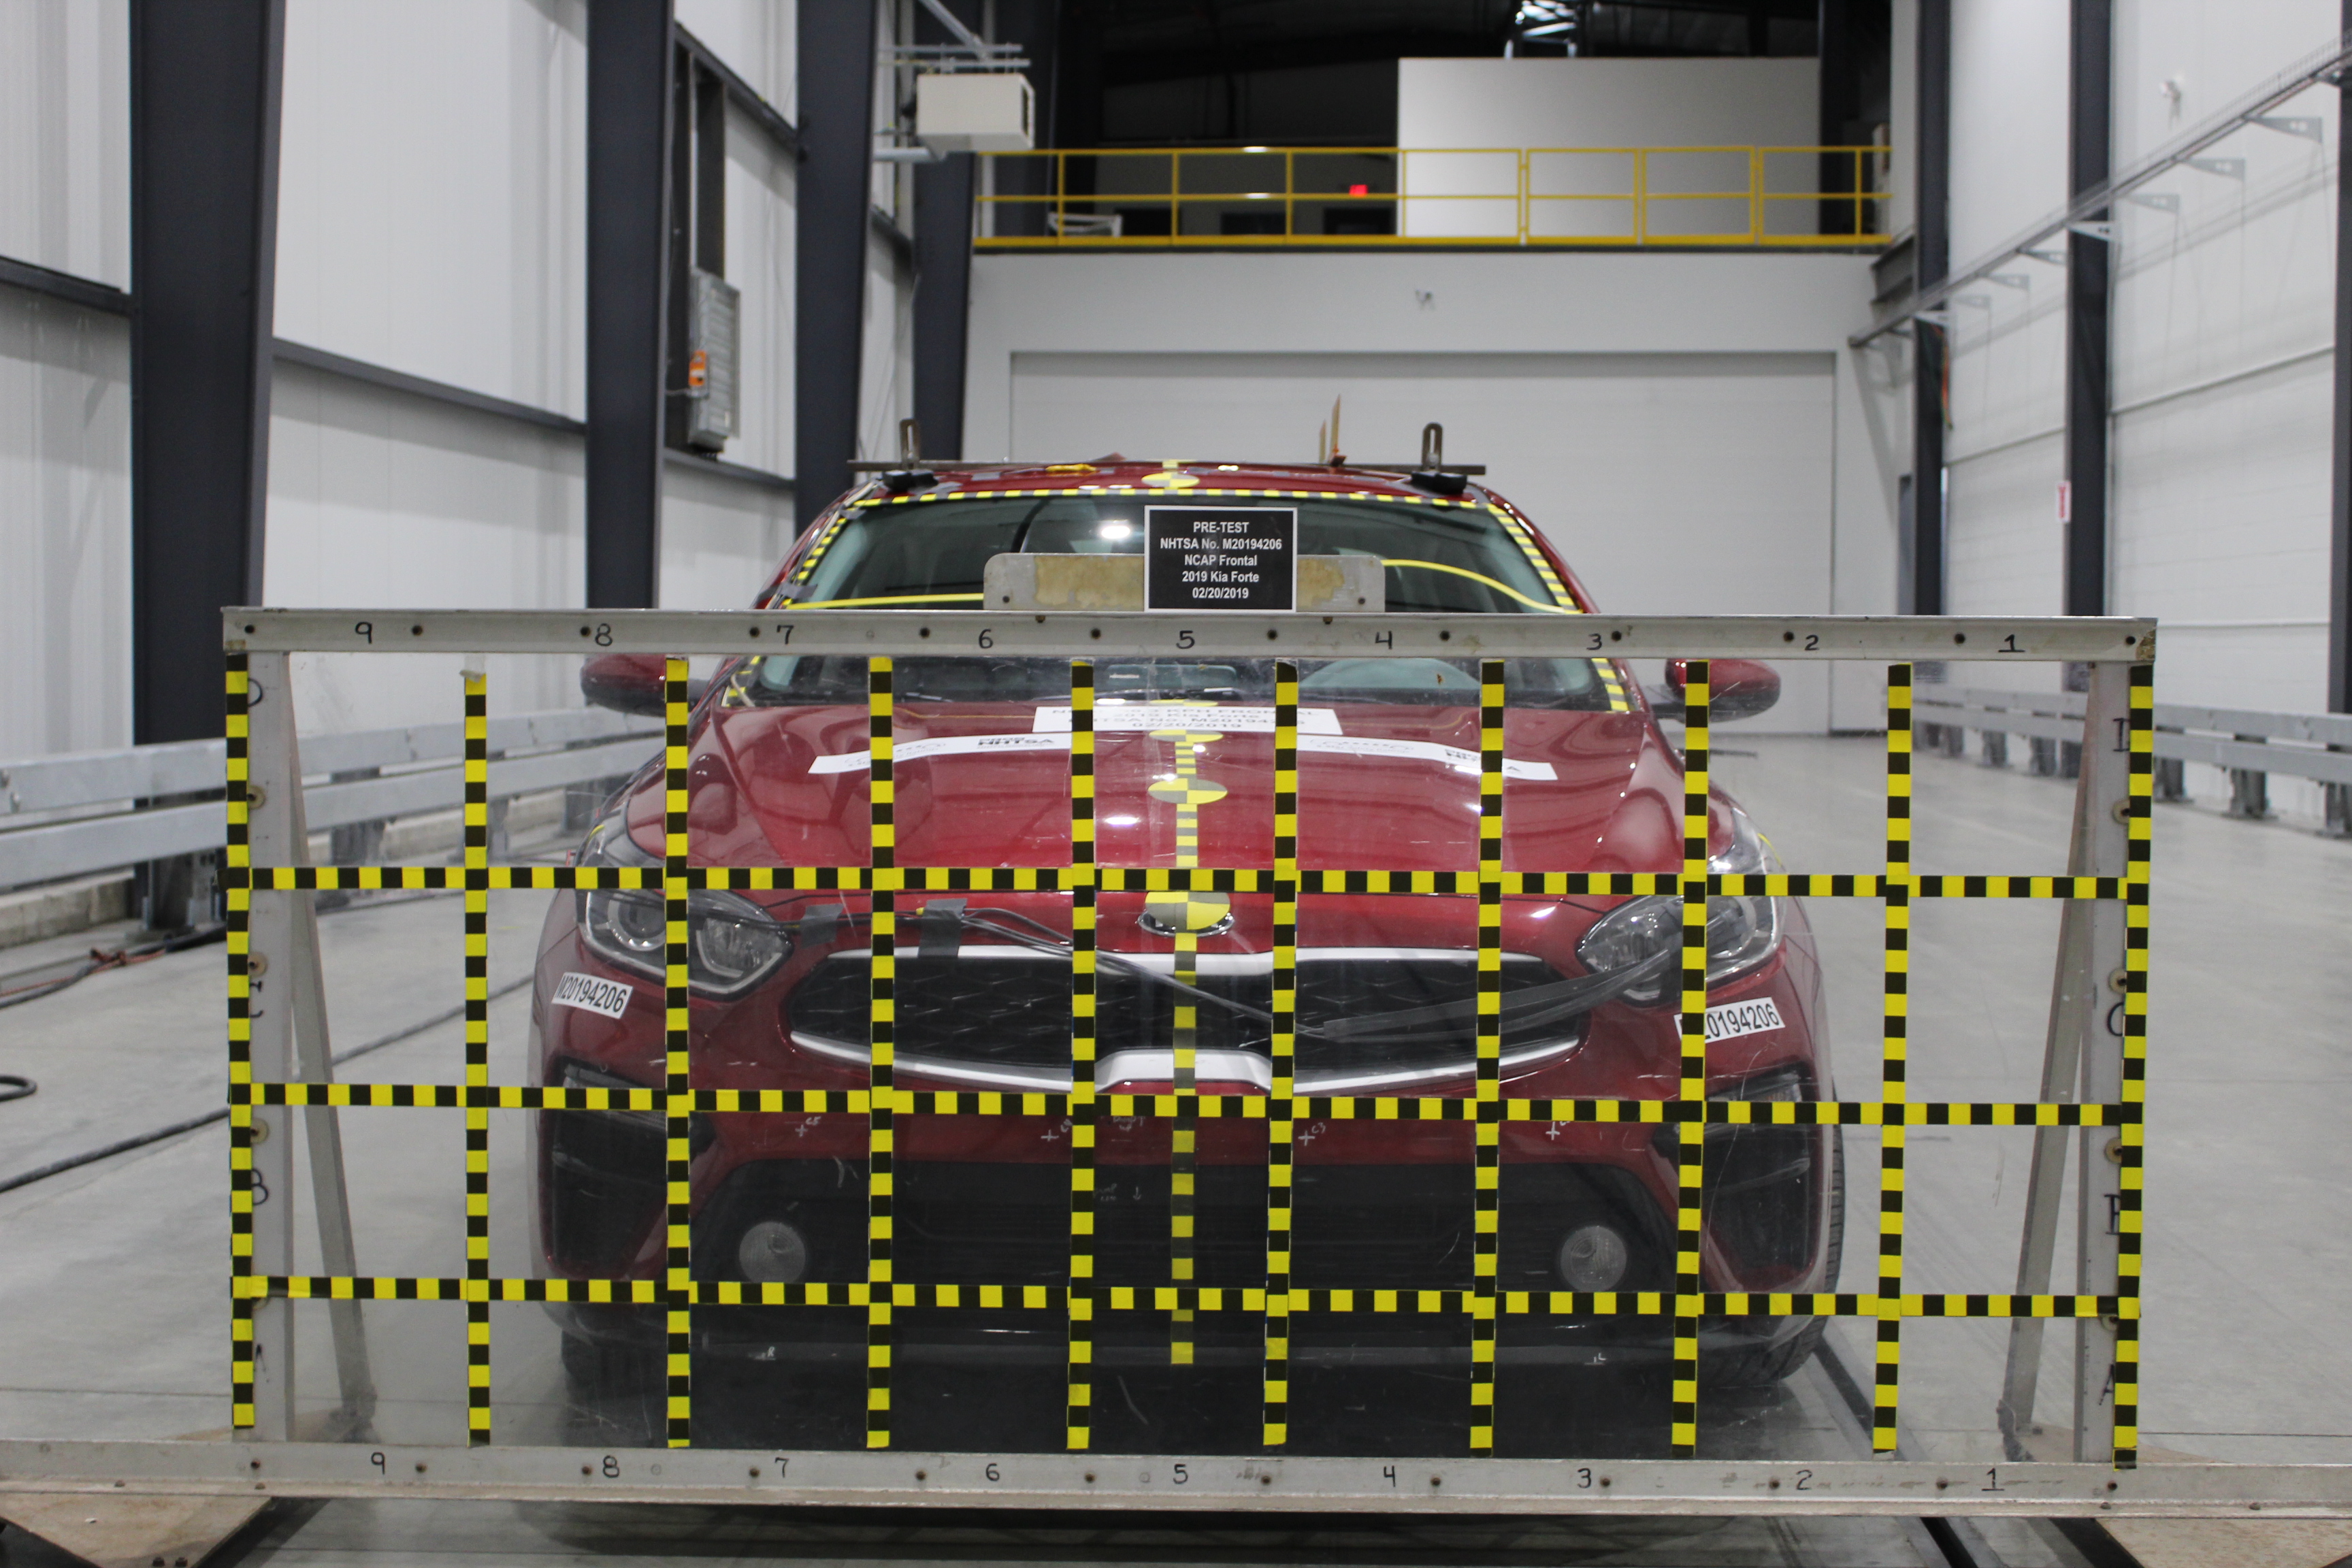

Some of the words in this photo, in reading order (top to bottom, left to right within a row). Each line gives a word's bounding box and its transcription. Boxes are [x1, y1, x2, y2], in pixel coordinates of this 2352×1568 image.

[1193, 521, 1250, 534] PRE-TEST
[1160, 538, 1199, 549] NHTSA
[1201, 538, 1220, 549] No.
[1222, 538, 1282, 550] M20194206
[1184, 554, 1215, 566] NCAP
[1219, 554, 1258, 566] Frontal
[1181, 571, 1207, 582] 2019
[1210, 571, 1228, 583] Kia
[1230, 571, 1260, 583] Forte
[1192, 587, 1250, 599] 02/20/2019
[355, 621, 373, 645] 9
[595, 623, 613, 647] 8
[776, 625, 795, 645] 7
[978, 629, 994, 650] 6
[1175, 630, 1196, 650] 5
[1375, 630, 1393, 650] 4
[1586, 633, 1603, 651] 3
[1804, 634, 1820, 651] 2
[1997, 634, 2025, 653] 1
[555, 975, 627, 1013] M20194206
[1680, 1003, 1780, 1039] 0194206
[371, 1452, 386, 1475] 9
[602, 1455, 621, 1478] 8
[774, 1457, 790, 1478] 7
[985, 1463, 1001, 1482] 6
[1172, 1463, 1189, 1485] 5
[1383, 1465, 1397, 1488] 4
[1577, 1467, 1592, 1488] 3
[1796, 1469, 1814, 1490] 2
[1981, 1467, 2005, 1491] 1
